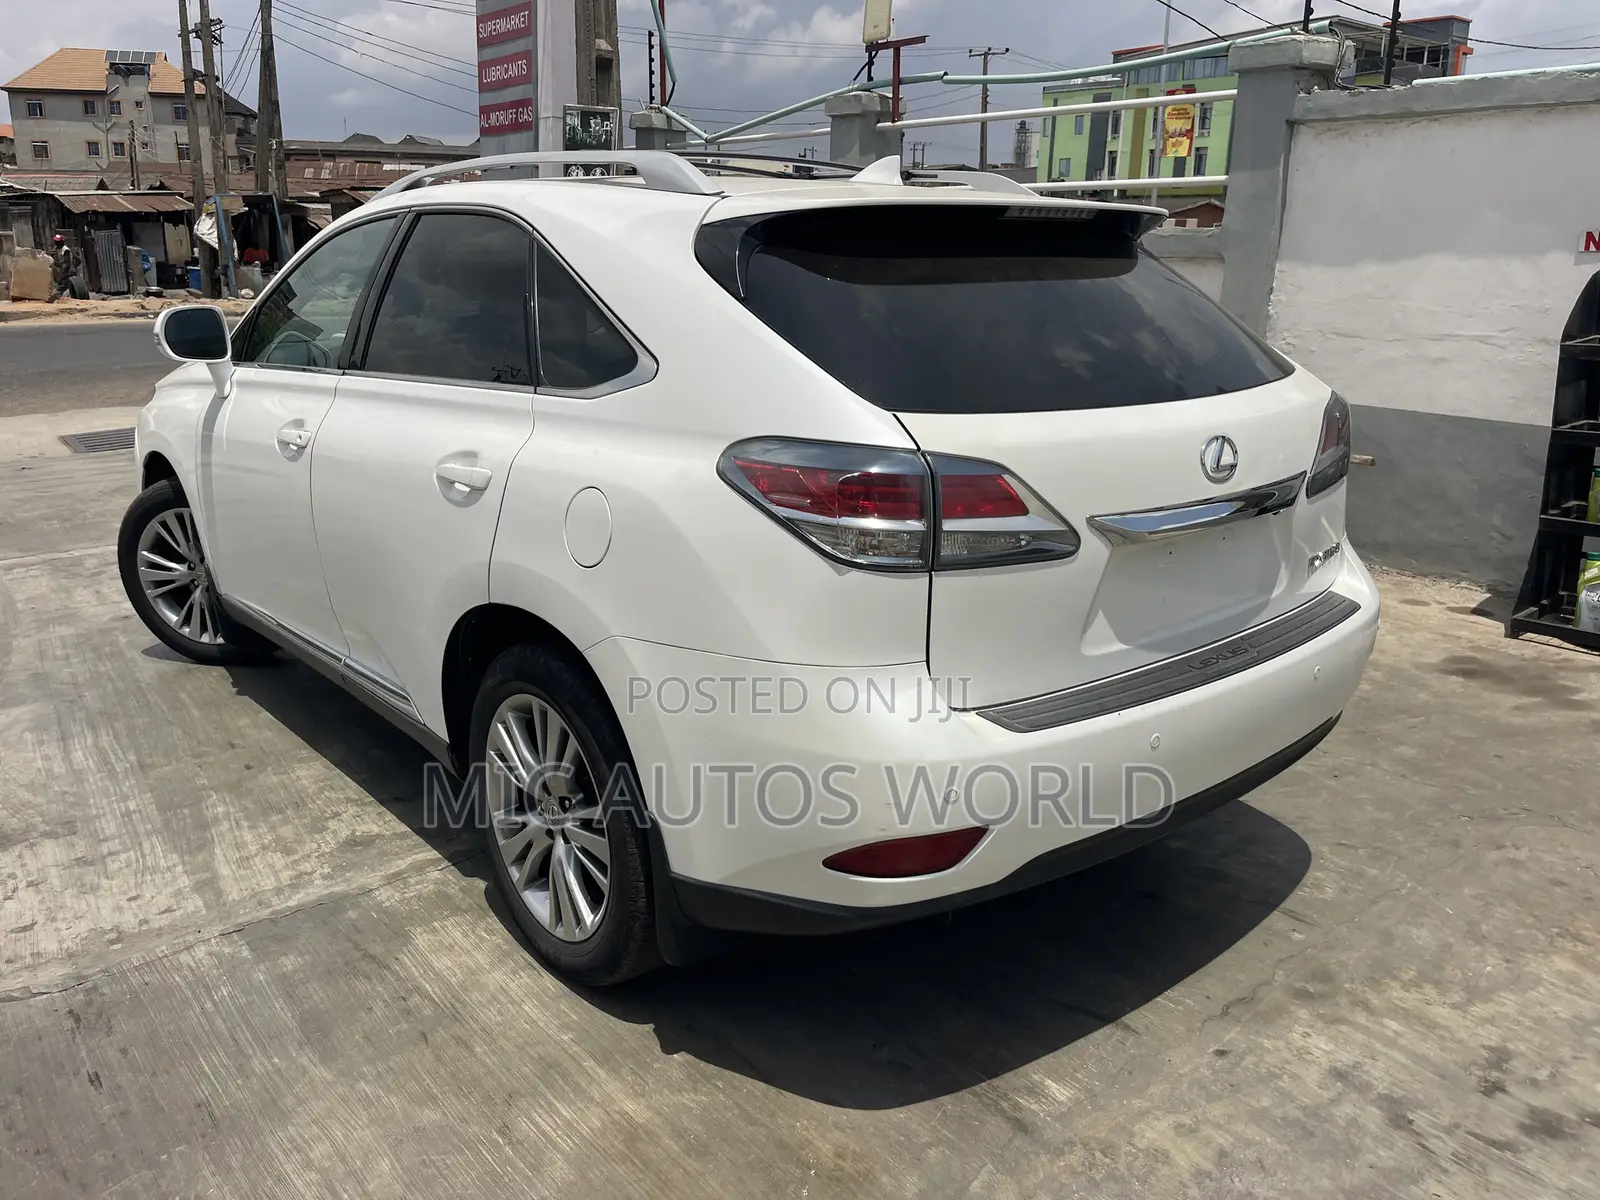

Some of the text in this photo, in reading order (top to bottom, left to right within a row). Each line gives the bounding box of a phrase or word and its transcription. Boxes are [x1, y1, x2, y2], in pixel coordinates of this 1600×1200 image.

[478, 11, 529, 38] SUPERMARKET
[482, 59, 527, 83] LUBRICANTS
[480, 106, 533, 128] AL-MORUFF GAS
